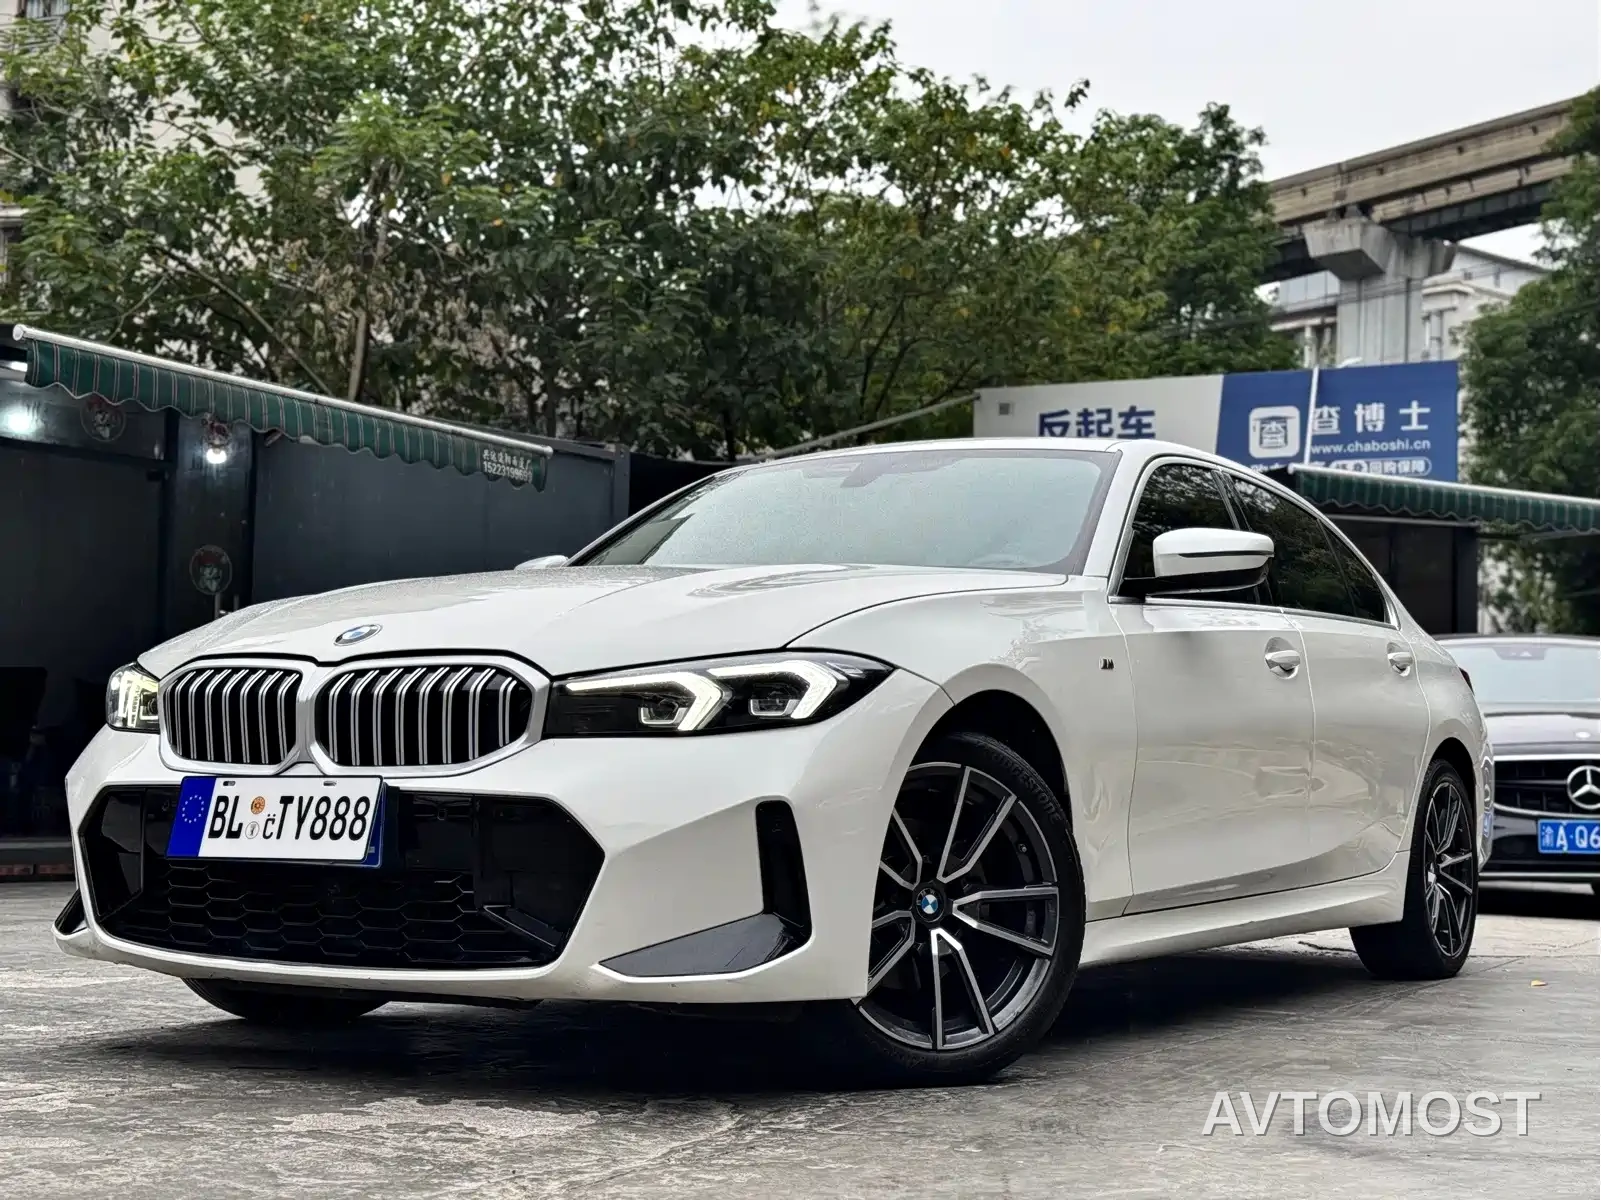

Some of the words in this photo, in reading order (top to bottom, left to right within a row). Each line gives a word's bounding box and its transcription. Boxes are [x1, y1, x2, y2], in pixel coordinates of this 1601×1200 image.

[1312, 400, 1431, 435] 查博士
[1312, 438, 1431, 454] www.chaboshi.cn
[208, 795, 243, 839] BL
